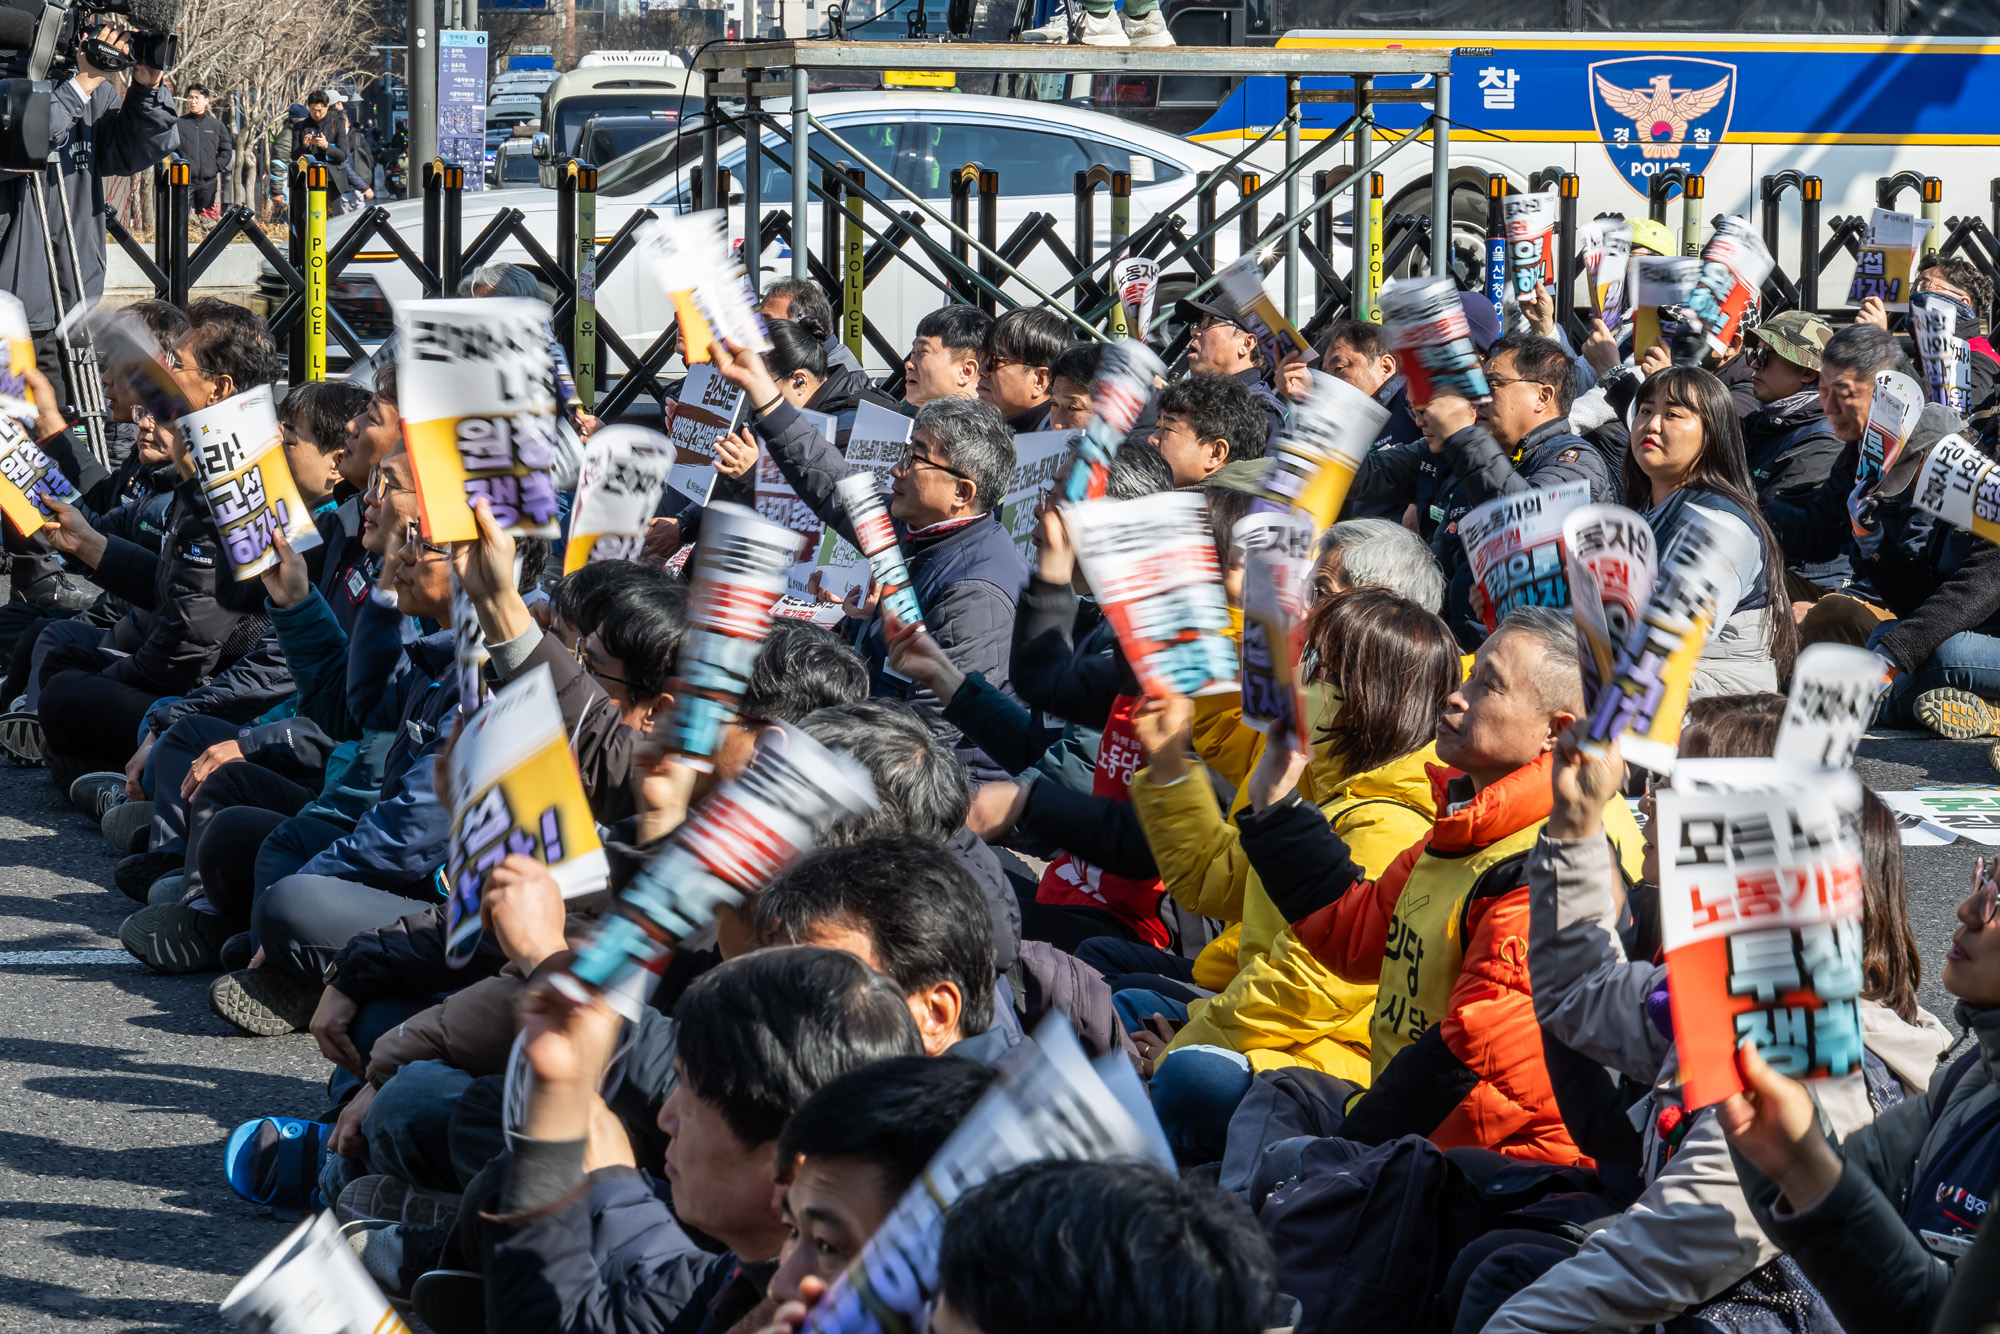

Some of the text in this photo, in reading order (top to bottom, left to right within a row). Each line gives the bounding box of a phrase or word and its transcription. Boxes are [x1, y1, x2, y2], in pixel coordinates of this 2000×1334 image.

[98, 45, 119, 56] FUJINON
[1459, 47, 1493, 56] ELEGANCE
[311, 238, 323, 335] POLICE
[849, 242, 861, 338] POLICE
[1369, 243, 1381, 320] POLIC
[702, 373, 740, 411] 감소되는
[206, 464, 267, 527] 교섭
[226, 498, 291, 565] 하자!
[1099, 740, 1141, 786] 노동당
[1964, 1193, 1989, 1215] 민주
